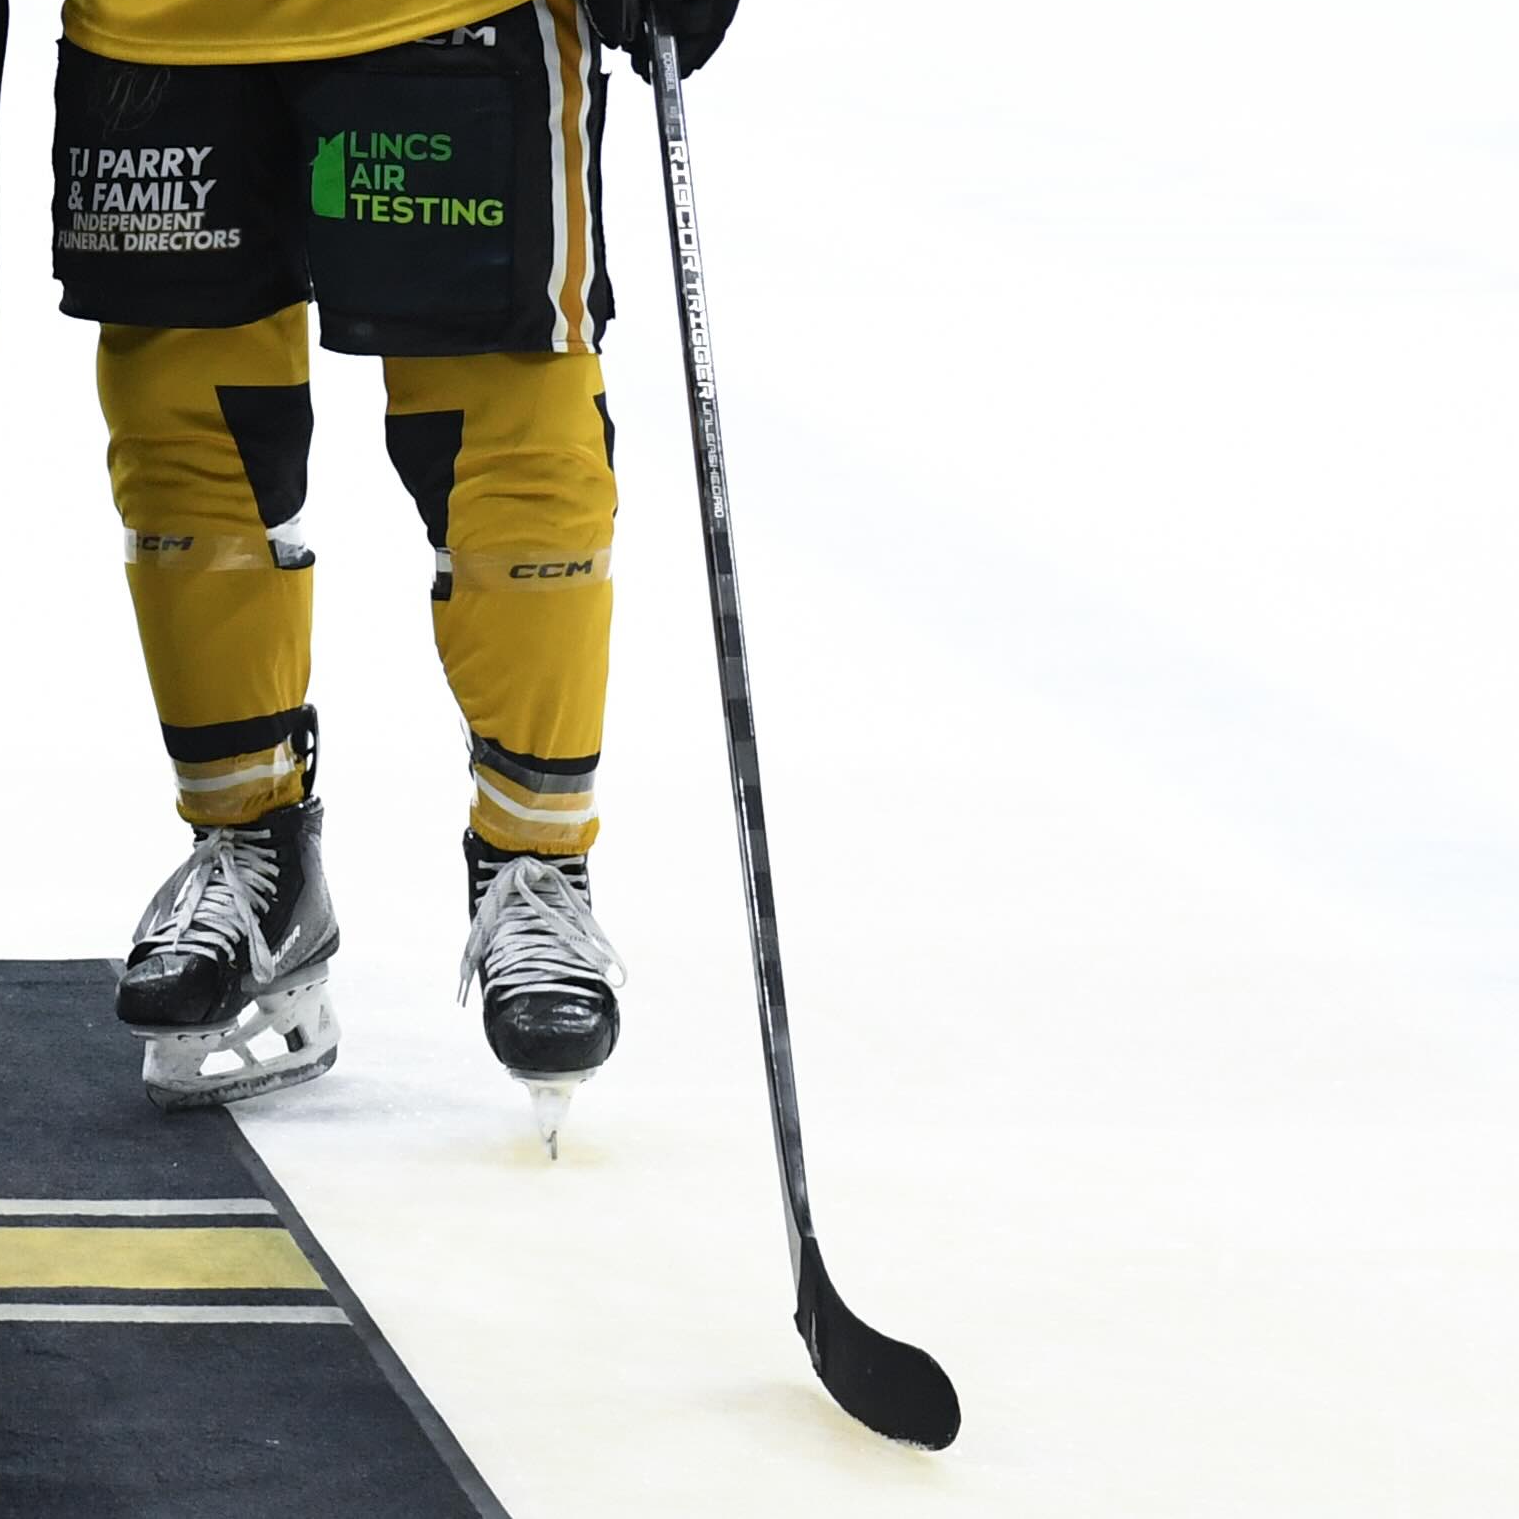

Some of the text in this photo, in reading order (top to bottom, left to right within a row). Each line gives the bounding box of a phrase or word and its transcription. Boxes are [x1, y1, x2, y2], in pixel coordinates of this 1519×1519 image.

[660, 51, 677, 92] CORBEIL
[69, 146, 214, 179] TJ PARRY
[348, 132, 453, 162] LINCS
[350, 165, 405, 192] AIR
[67, 179, 218, 212] & FAMILY
[349, 194, 504, 227] TESTING
[668, 140, 702, 273] RIBCOR
[73, 211, 206, 233] INDEPENDENT
[57, 228, 242, 252] FUNERAL DIRECTORS
[684, 277, 716, 399] TRIGGER
[507, 556, 594, 580] CCM
